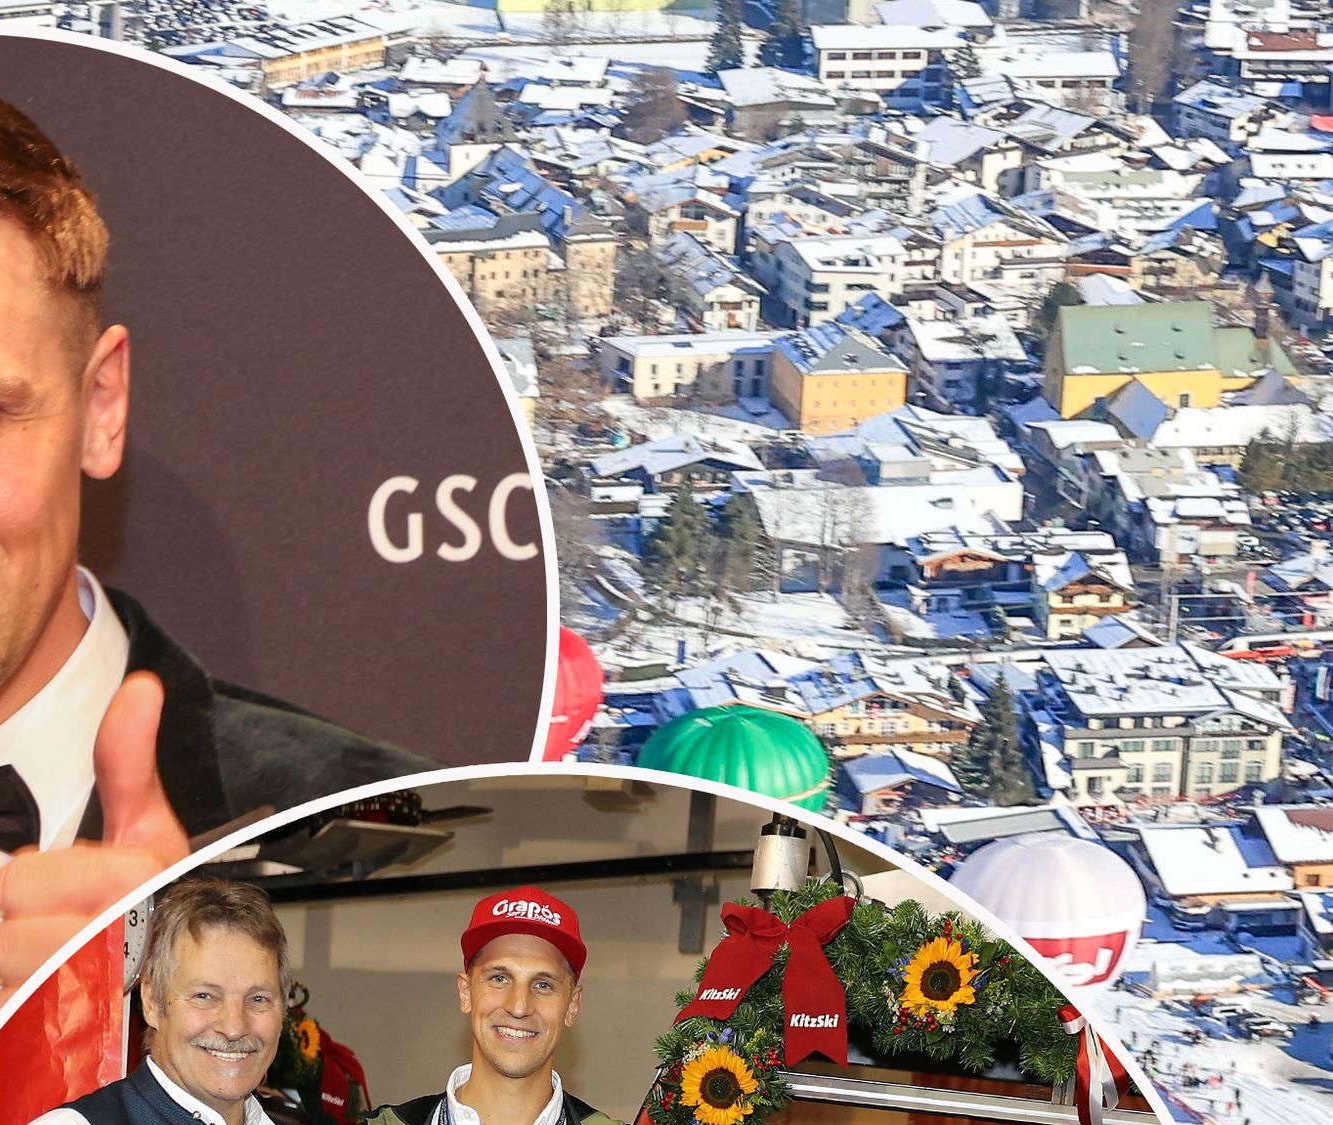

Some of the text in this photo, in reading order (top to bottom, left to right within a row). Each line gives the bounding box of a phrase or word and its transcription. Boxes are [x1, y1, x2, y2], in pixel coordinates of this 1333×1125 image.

[367, 472, 539, 563] GSC
[128, 909, 138, 927] 3
[699, 988, 741, 1001] KitzSki
[790, 1013, 839, 1028] KitzSki
